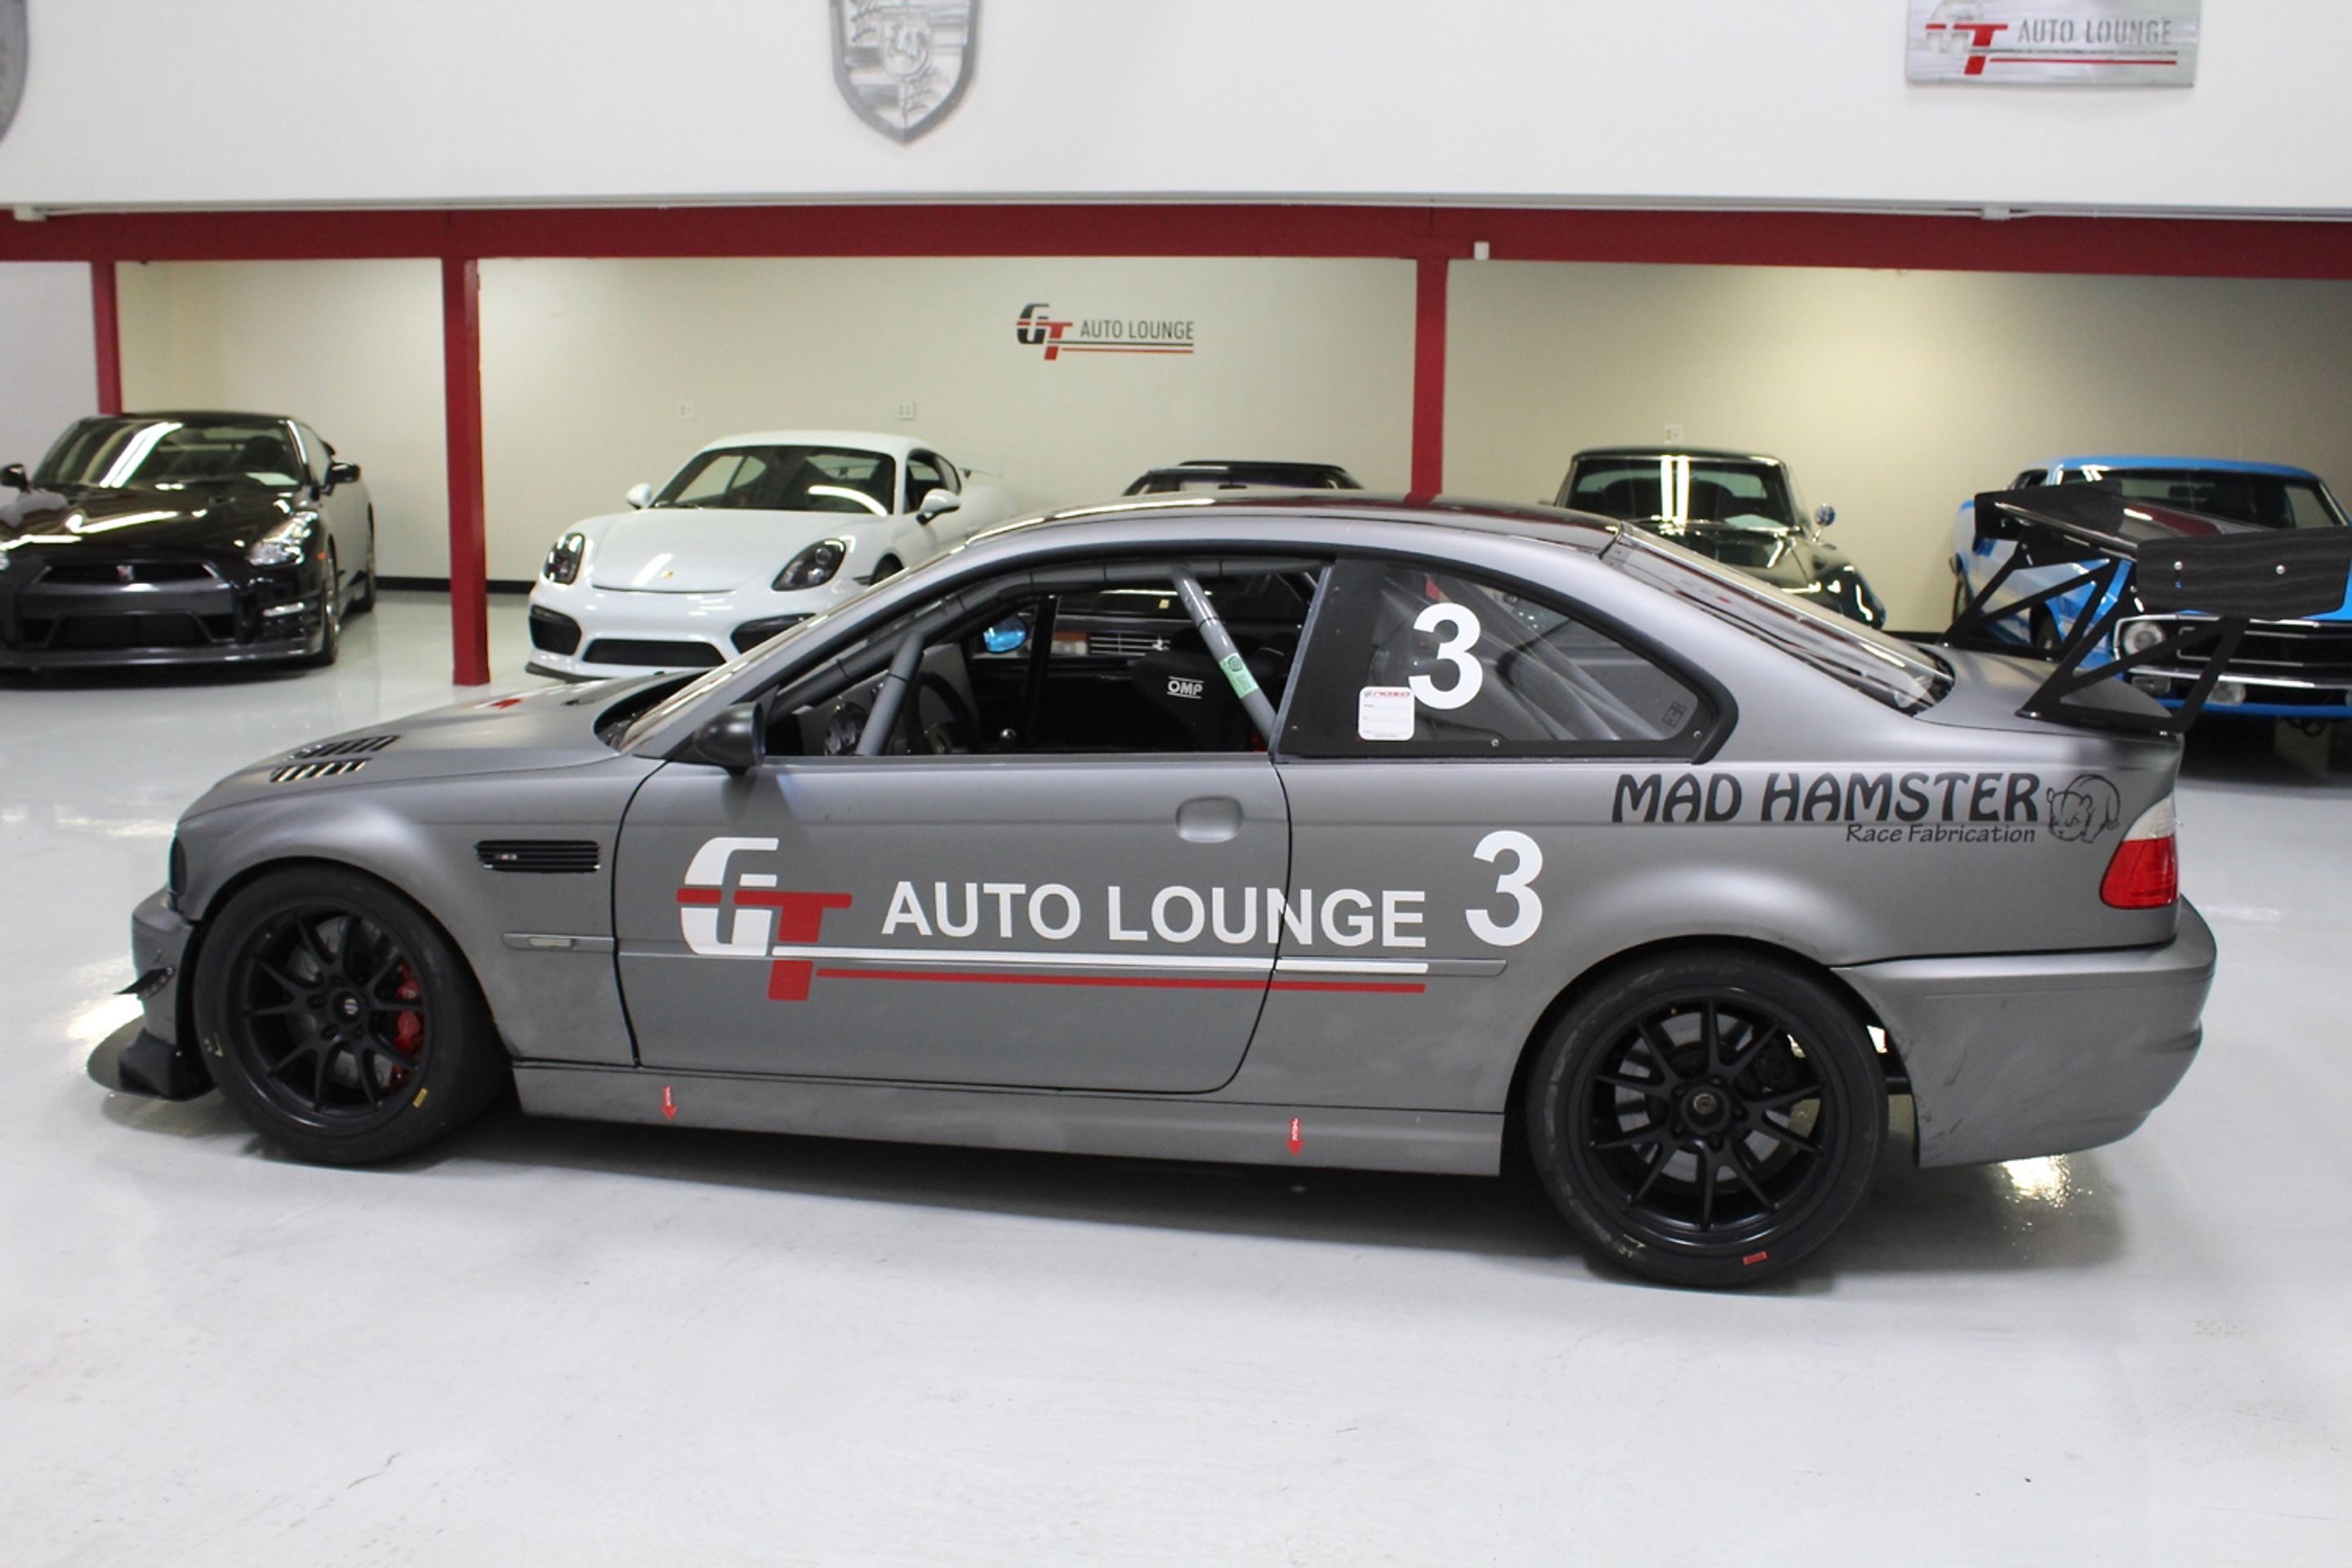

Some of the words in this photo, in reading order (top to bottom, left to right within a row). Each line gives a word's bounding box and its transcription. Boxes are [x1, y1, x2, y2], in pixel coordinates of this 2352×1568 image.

[2017, 20, 2074, 43] AUTO
[2086, 20, 2172, 46] LOUNGE
[1016, 303, 1073, 360] GT
[1080, 319, 1123, 339] AUTO
[1129, 320, 1194, 340] LOUNGE
[1408, 603, 1483, 710] 3
[1168, 679, 1203, 696] OMP
[1611, 773, 1742, 823] MAD
[1761, 772, 2039, 822] HAMSTER
[1846, 823, 1903, 843] Race
[1908, 823, 2036, 843] Fabrication
[1465, 830, 1544, 947] 3
[675, 836, 853, 1001] GT
[881, 881, 1081, 940] AUTO
[1107, 885, 1428, 948] LOUNGE
